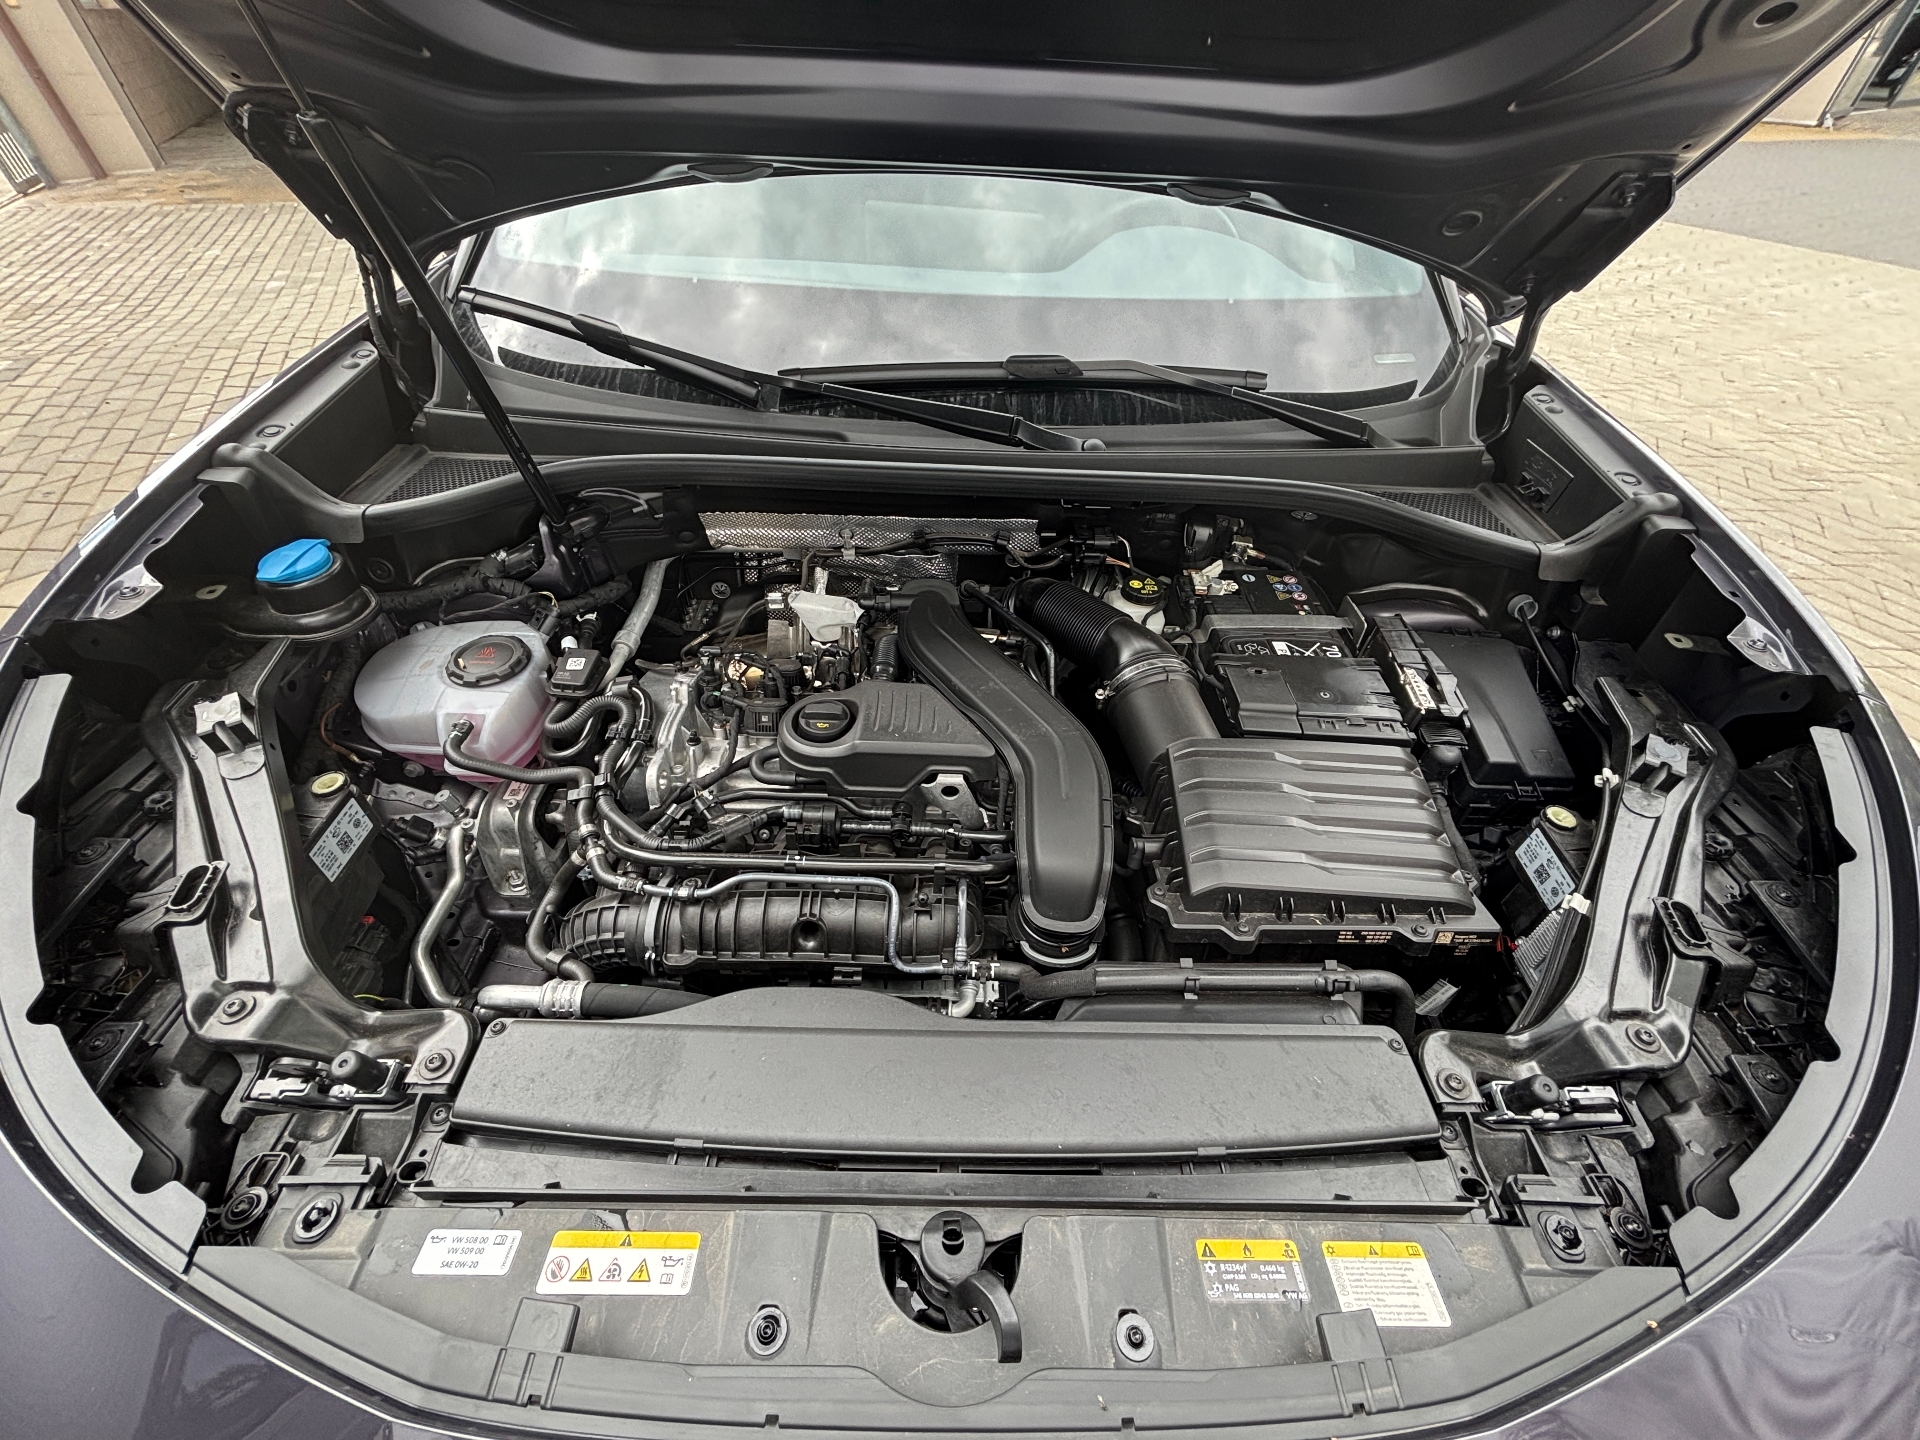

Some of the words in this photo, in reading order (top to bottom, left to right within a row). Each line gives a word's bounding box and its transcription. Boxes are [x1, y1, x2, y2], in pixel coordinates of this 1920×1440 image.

[1322, 645, 1342, 658] 70
[1220, 1263, 1247, 1273] R-1234yf
[1277, 1265, 1286, 1273] kg
[1298, 1292, 1309, 1300] AG
